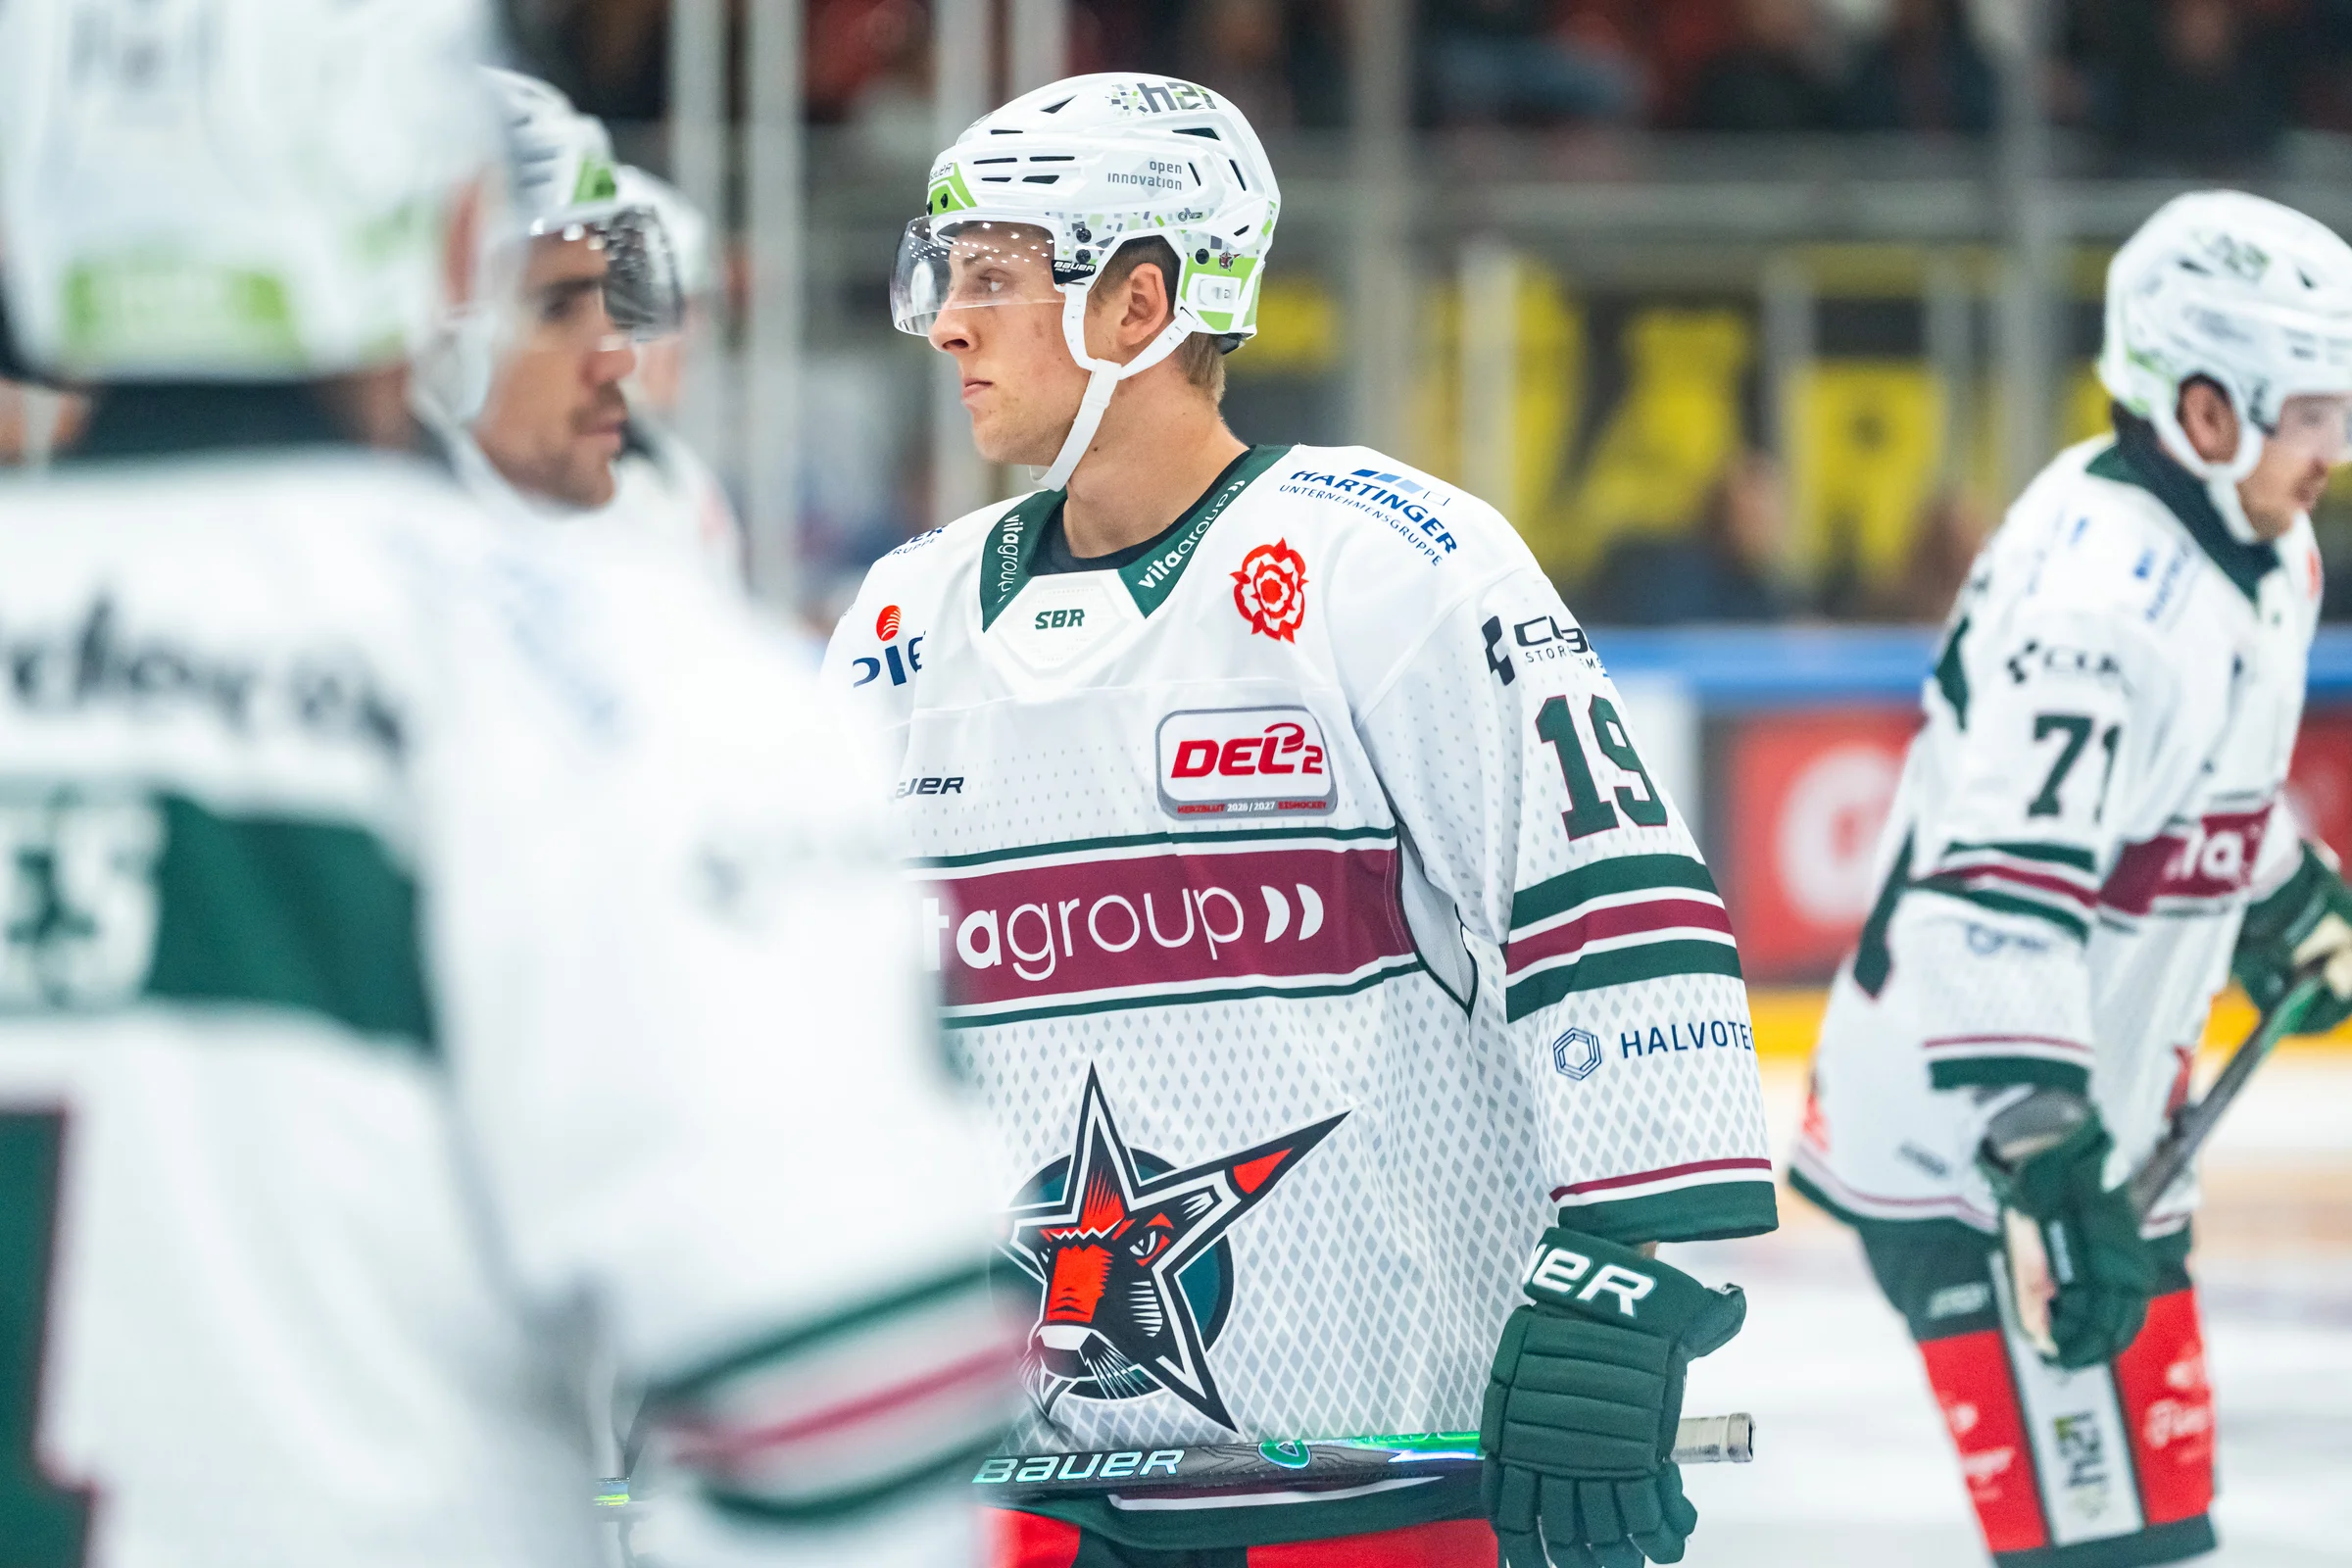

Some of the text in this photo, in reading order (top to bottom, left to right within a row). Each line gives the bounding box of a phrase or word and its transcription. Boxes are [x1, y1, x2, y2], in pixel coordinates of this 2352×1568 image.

[1107, 172, 1182, 191] innovation
[1150, 161, 1182, 174] open
[1054, 261, 1096, 272] BAUER
[1279, 484, 1443, 566] UNTERNEHMENSGRUPPE
[1290, 470, 1457, 554] HARTINGER
[1035, 609, 1085, 630] SBR
[1535, 693, 1669, 843] 19
[1620, 1019, 1757, 1058] HALVOTE
[971, 1449, 1186, 1484] BAUER
